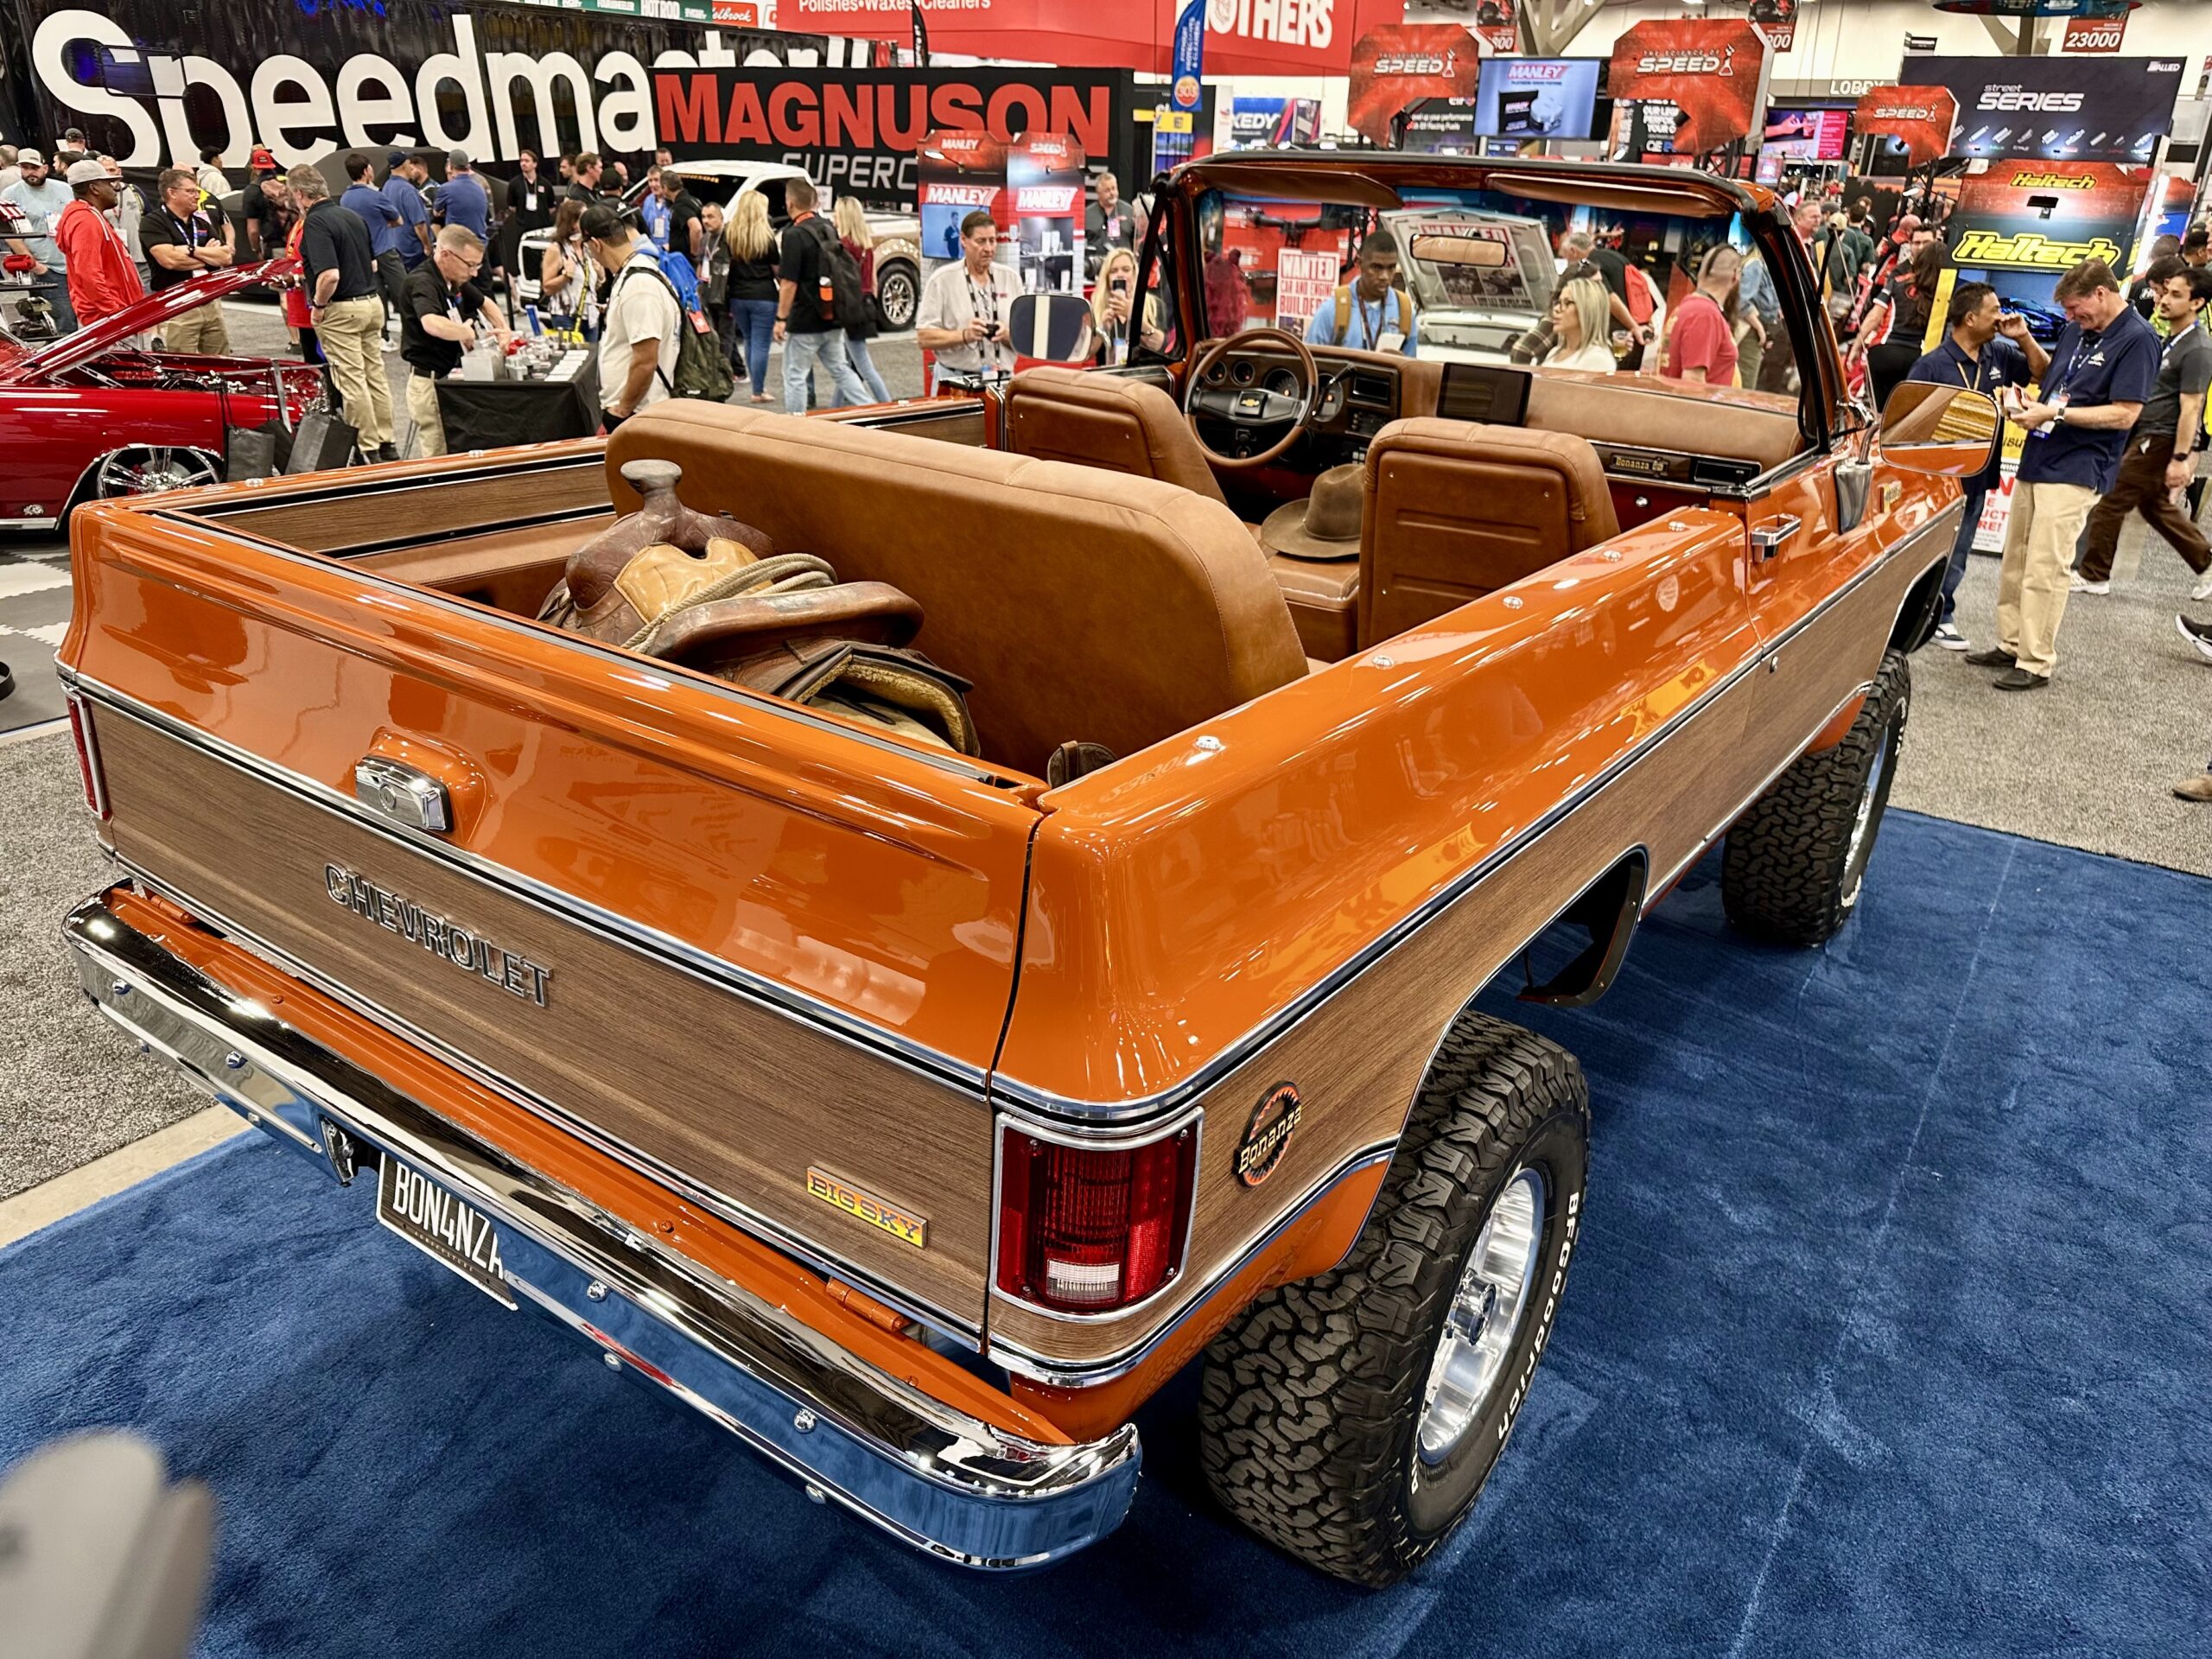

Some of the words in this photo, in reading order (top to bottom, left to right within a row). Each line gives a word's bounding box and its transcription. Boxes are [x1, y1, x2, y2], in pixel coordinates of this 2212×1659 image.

[2065, 32, 2120, 48] 23000
[1373, 58, 1444, 73] SPEED
[1508, 65, 1563, 79] MANLEY
[1636, 57, 1720, 73] SPEED
[1983, 84, 2023, 92] street
[1976, 92, 2084, 111] SERIES
[654, 73, 1110, 157] MAGNUSON
[1872, 108, 1929, 119] SPEED
[941, 138, 979, 150] MANLEY
[2012, 173, 2096, 188] Haltech
[927, 186, 988, 206] MANLEY
[1018, 188, 1069, 209] MANLEY
[1956, 234, 2116, 265] Haltech
[1282, 256, 1335, 279] WANTED
[1281, 280, 1294, 295] CAR
[1296, 282, 1307, 295] AND
[1616, 457, 1649, 470] Bonanza
[324, 862, 554, 1008] CHEVROLET
[1238, 1103, 1302, 1174] Bonanza
[810, 1174, 855, 1210] BIG
[861, 1198, 919, 1239] SKY
[392, 1160, 504, 1280] BON4NZA
